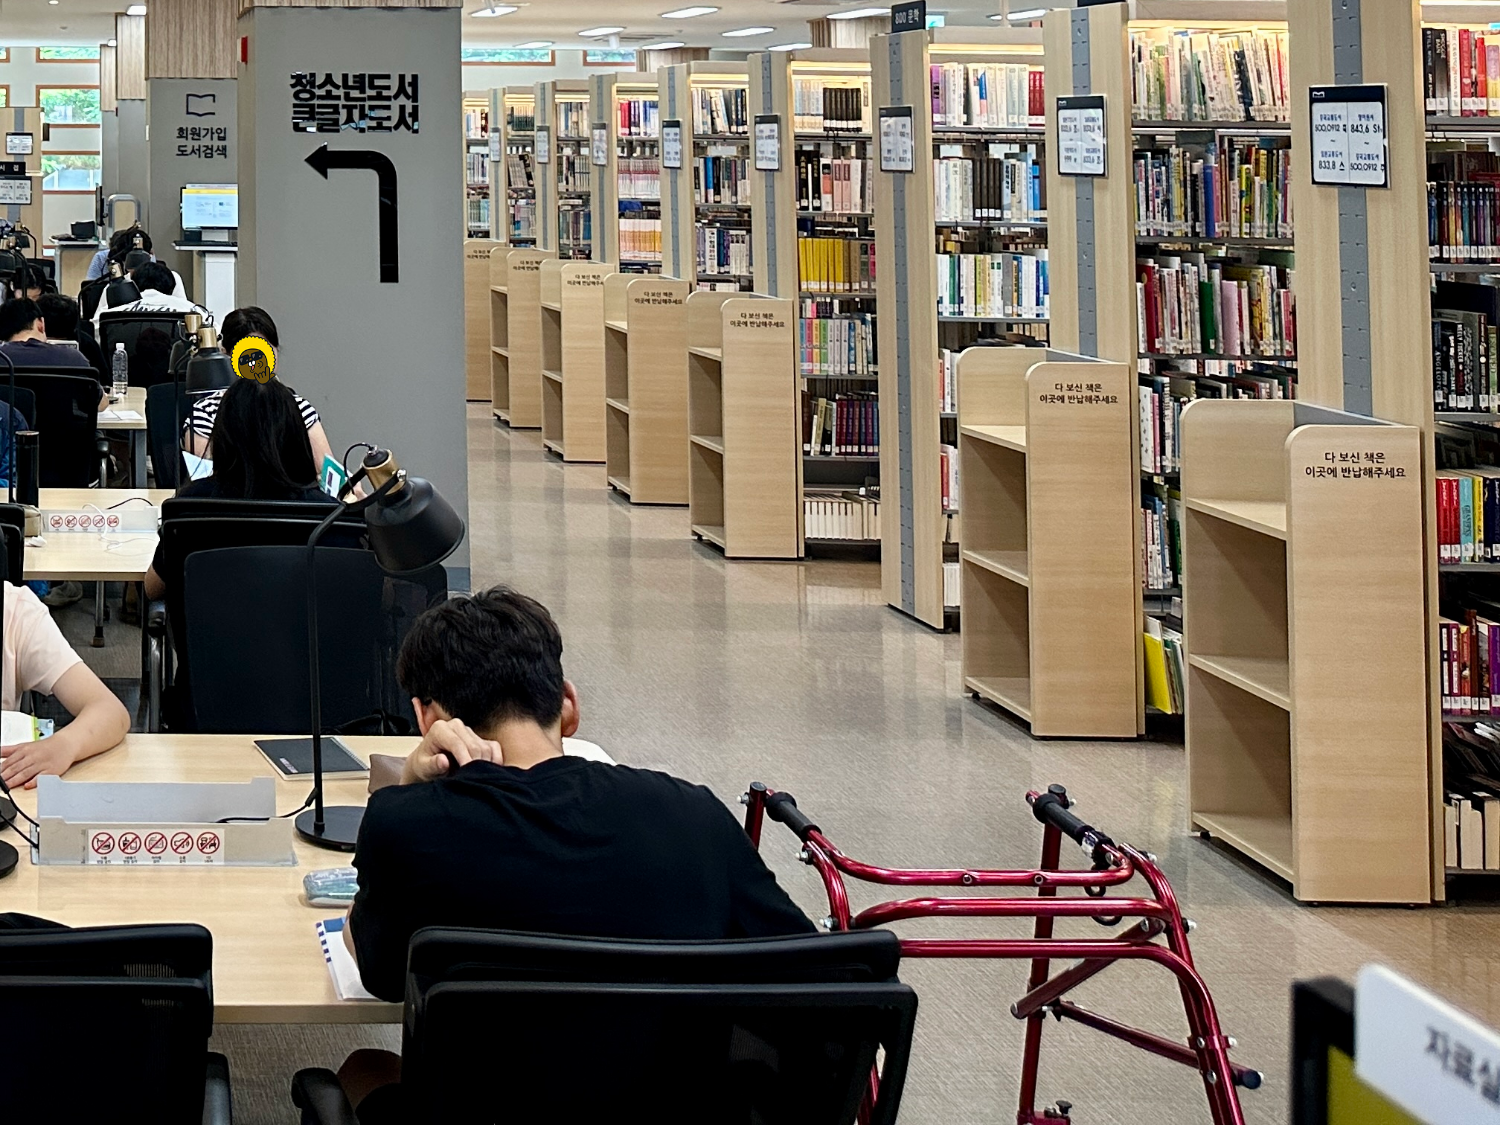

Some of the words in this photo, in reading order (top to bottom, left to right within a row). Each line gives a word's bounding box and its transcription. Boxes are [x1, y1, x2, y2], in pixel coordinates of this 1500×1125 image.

[290, 72, 419, 103] 청소년도서
[292, 103, 419, 134] 큰글자도서
[176, 126, 227, 141] 회원가입
[175, 144, 227, 159] 도서검색
[1054, 383, 1064, 393] 다
[1065, 383, 1083, 393] 보신
[1085, 383, 1102, 393] 책은
[1039, 394, 1066, 404] 이곳에
[1067, 394, 1119, 405] 반납해주세요
[1324, 451, 1336, 464] 다
[1338, 452, 1360, 464] 보신
[1363, 452, 1386, 464] 책은
[1305, 466, 1338, 478] 이곳에
[1340, 466, 1407, 479] 반납해주세요
